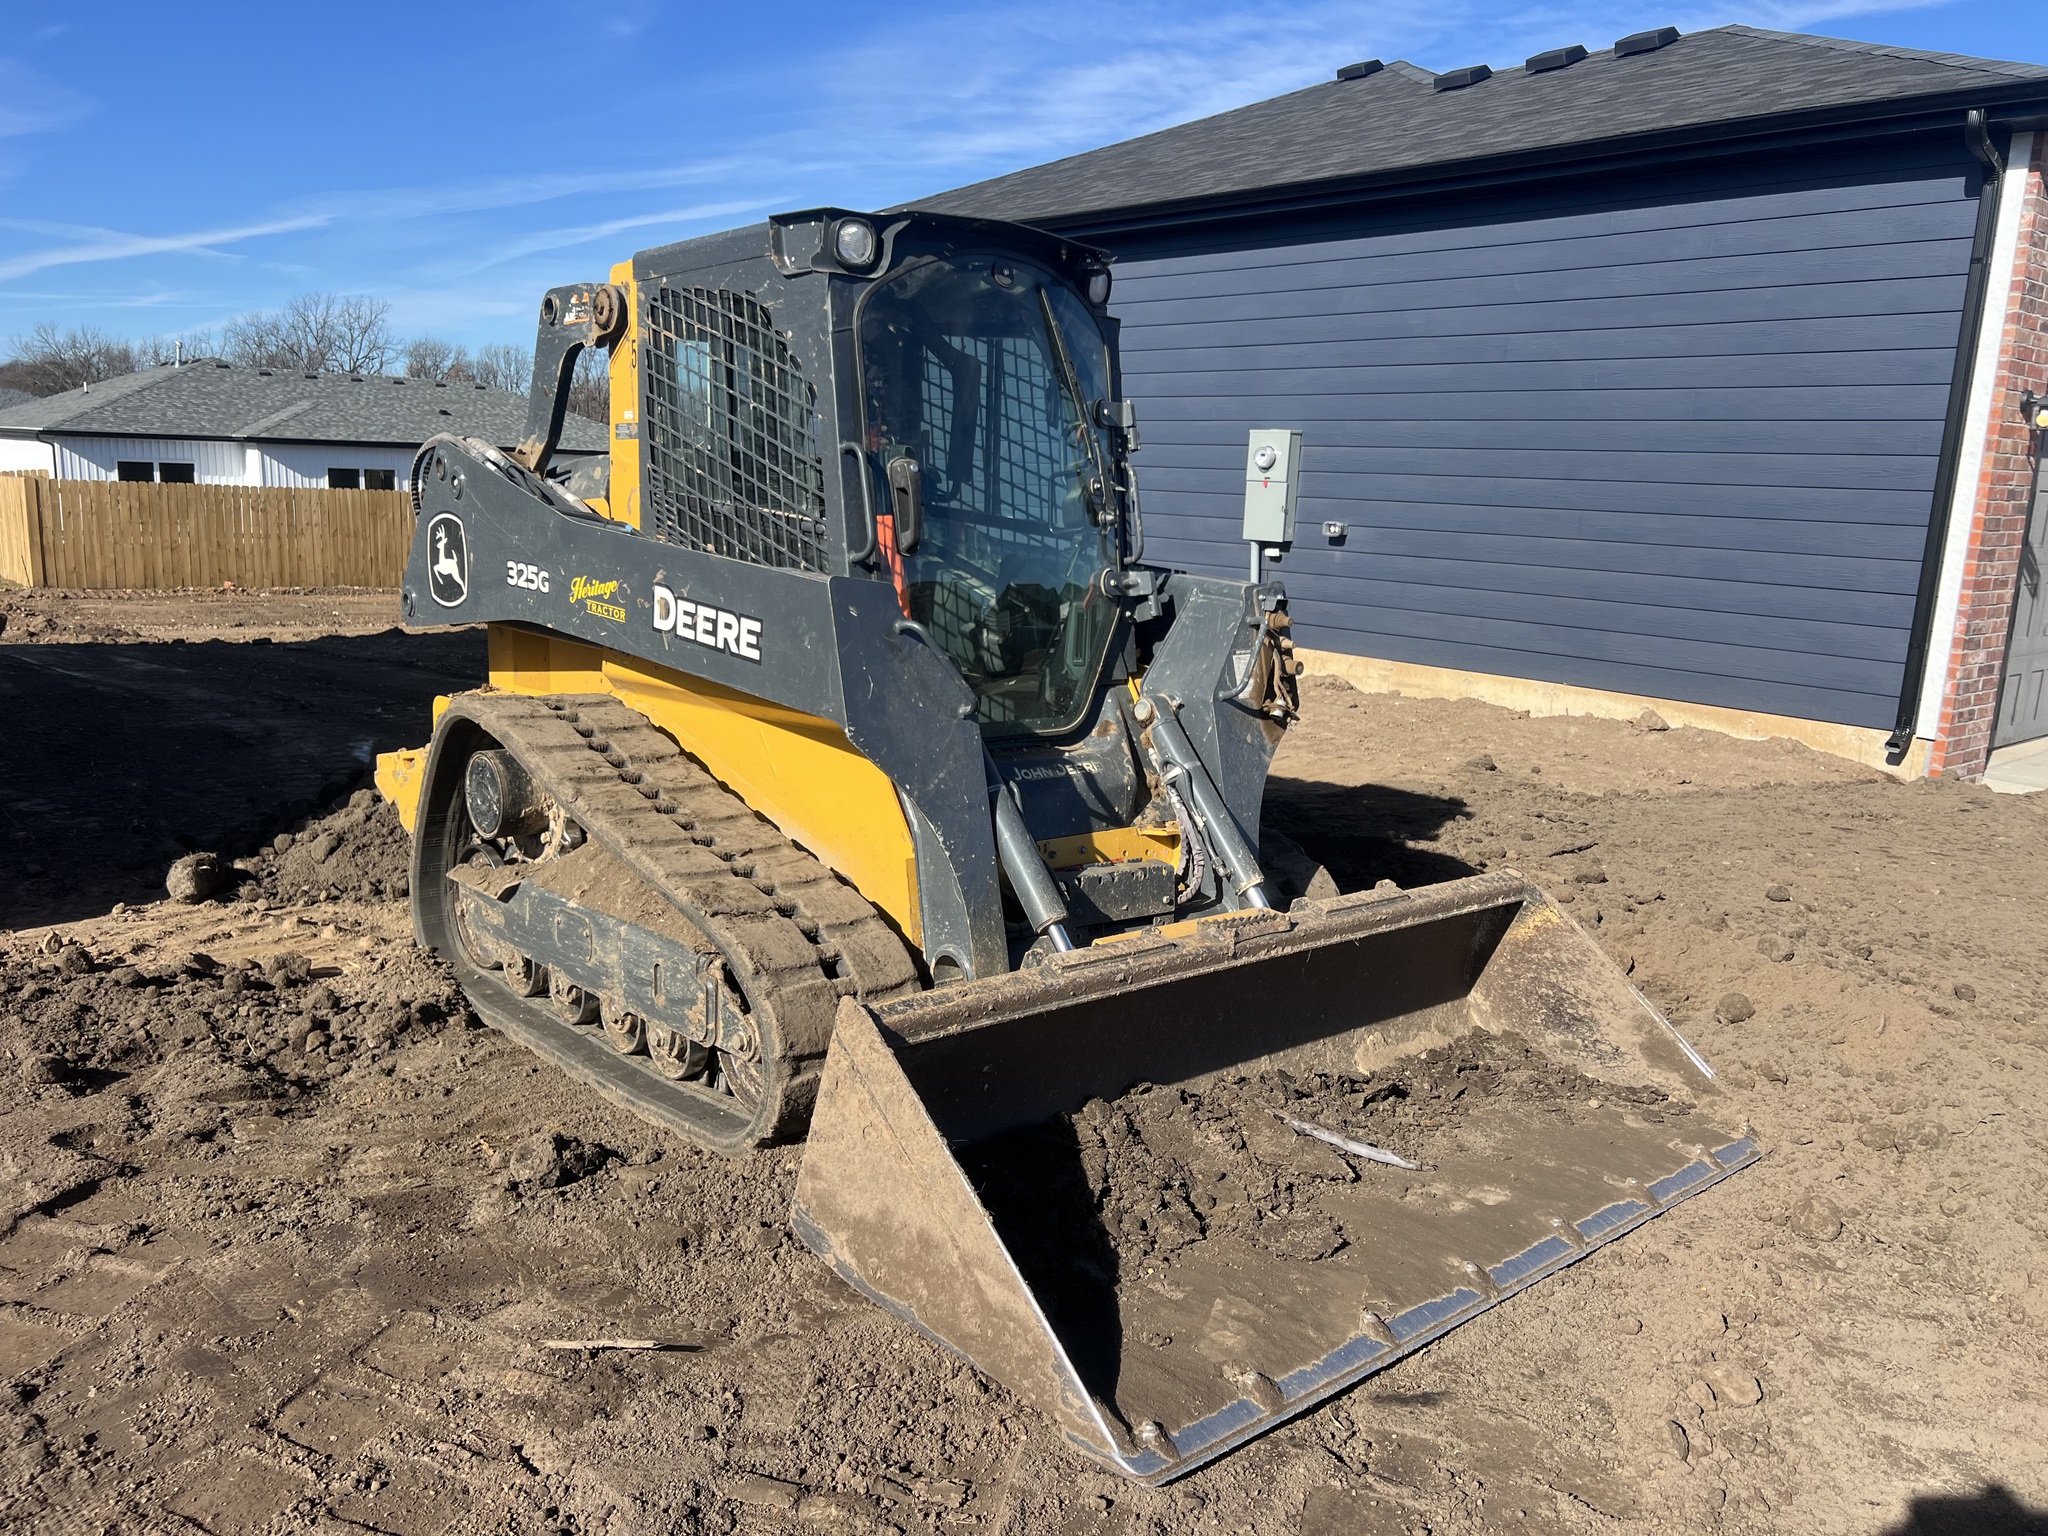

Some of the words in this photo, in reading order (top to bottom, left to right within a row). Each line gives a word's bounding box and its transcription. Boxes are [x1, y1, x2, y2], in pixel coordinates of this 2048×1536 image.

[506, 560, 550, 594] 325G
[569, 575, 618, 604] Heritage
[586, 601, 626, 621] TRACTOR
[653, 584, 762, 661] DEERE
[1012, 766, 1055, 781] JOHN
